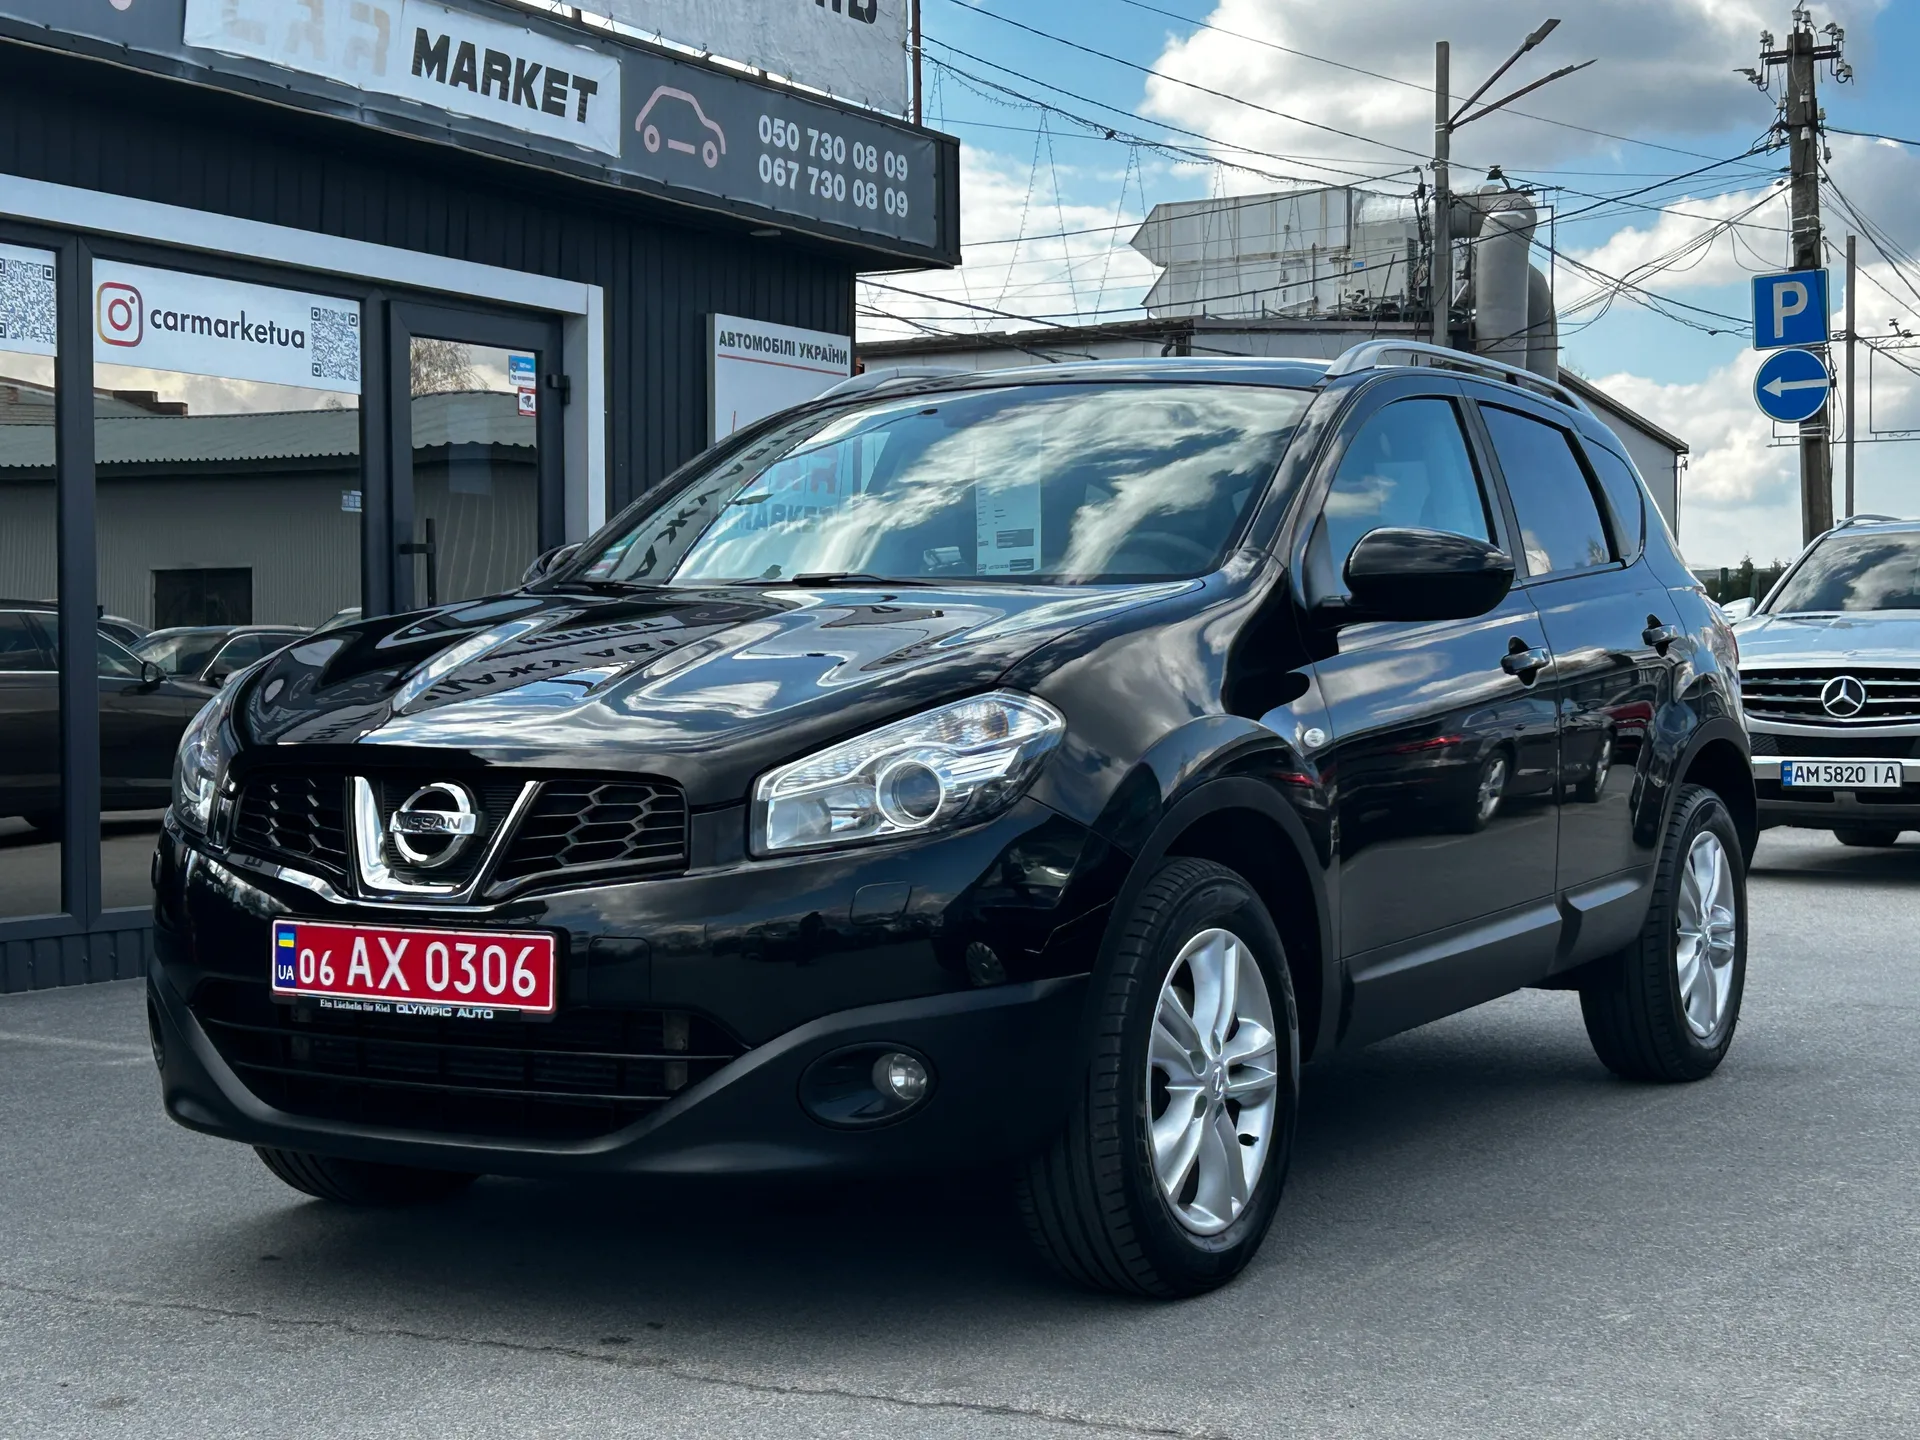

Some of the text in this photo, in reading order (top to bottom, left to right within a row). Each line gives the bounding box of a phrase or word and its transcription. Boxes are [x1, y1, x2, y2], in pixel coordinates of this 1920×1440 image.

[411, 27, 599, 124] MARKET
[758, 114, 908, 181] 050 730 08 09
[758, 153, 909, 218] 067 730 08 09
[150, 308, 305, 349] carmarketua
[1772, 281, 1809, 339] P
[719, 330, 848, 366] АВТОМОБІЛІ УКРАЇНИ
[1794, 765, 1820, 783] AM
[1823, 765, 1866, 783] 5820
[399, 816, 462, 830] NISSAN
[277, 964, 295, 981] UA
[299, 936, 537, 998] 06 AX 0306
[396, 1004, 494, 1019] OLYMPIC AUTO
